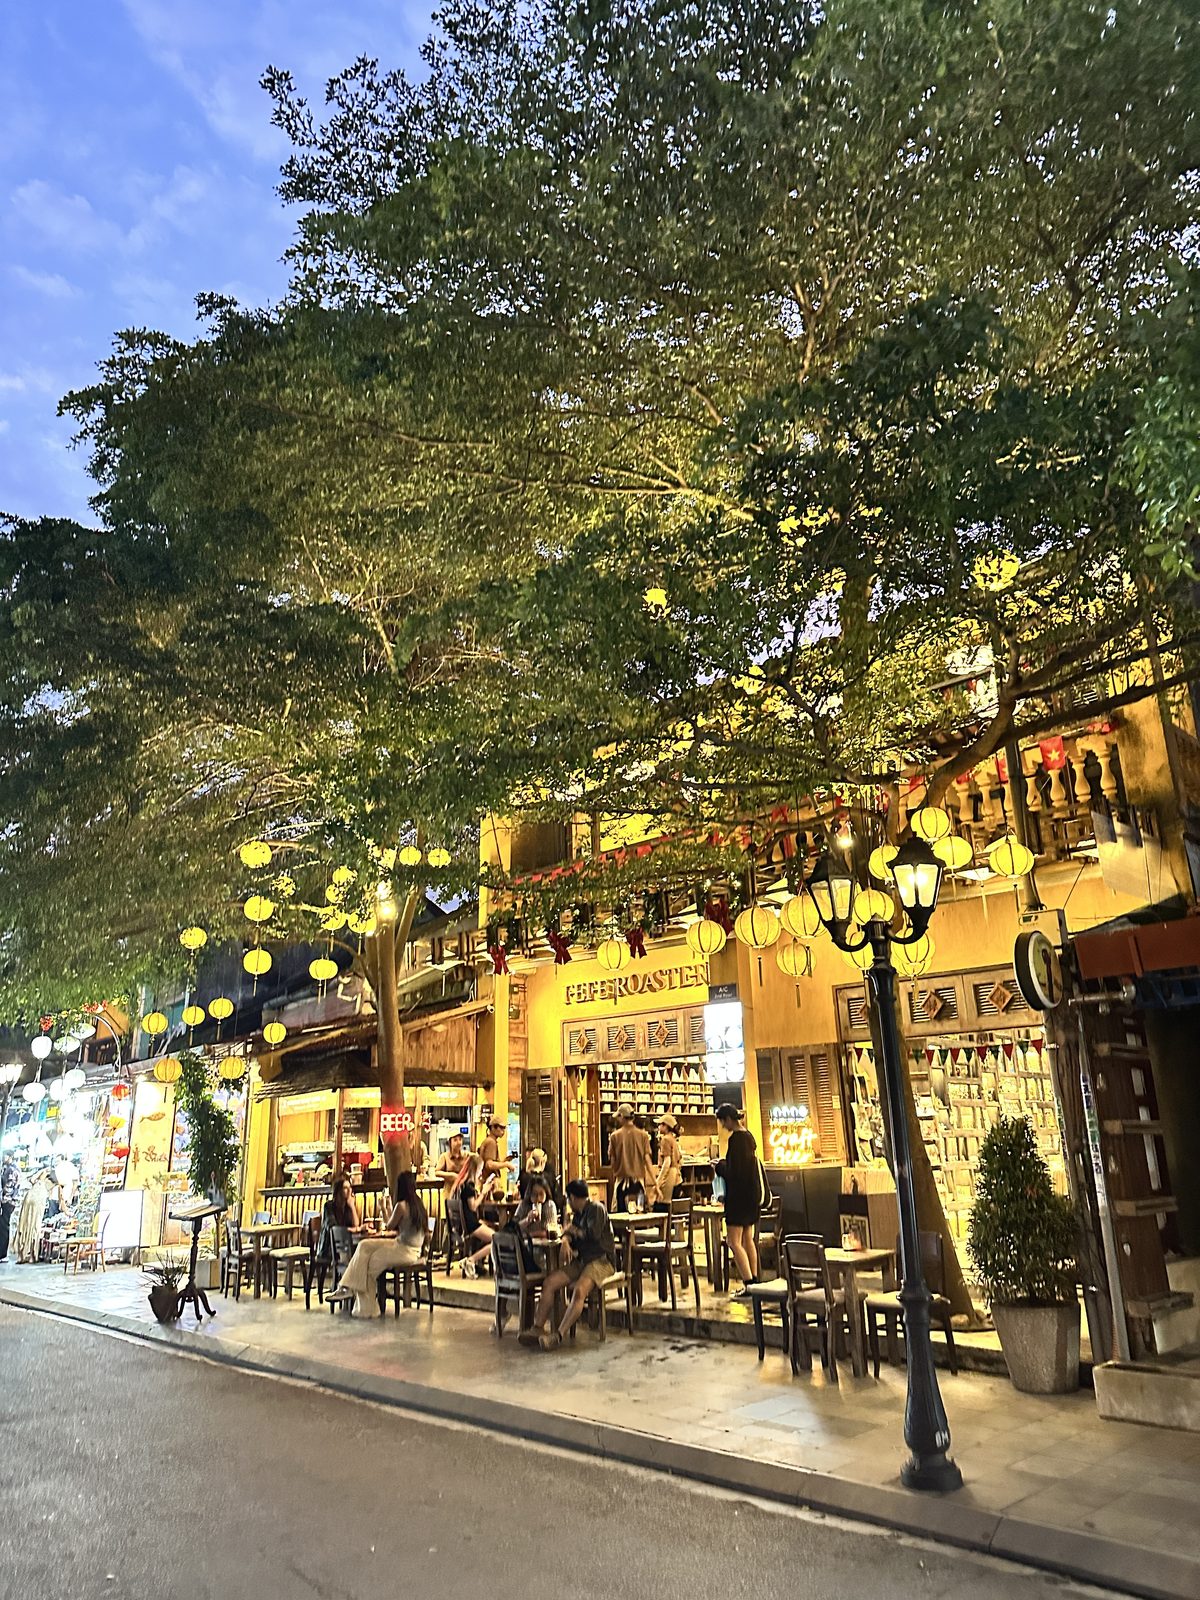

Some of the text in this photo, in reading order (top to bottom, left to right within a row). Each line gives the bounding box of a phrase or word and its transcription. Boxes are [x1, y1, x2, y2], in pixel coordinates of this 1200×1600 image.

[565, 978, 614, 1005] FEFE
[381, 1113, 411, 1132] BEER
[769, 1127, 818, 1149] Craft
[773, 1146, 812, 1165] Beer
